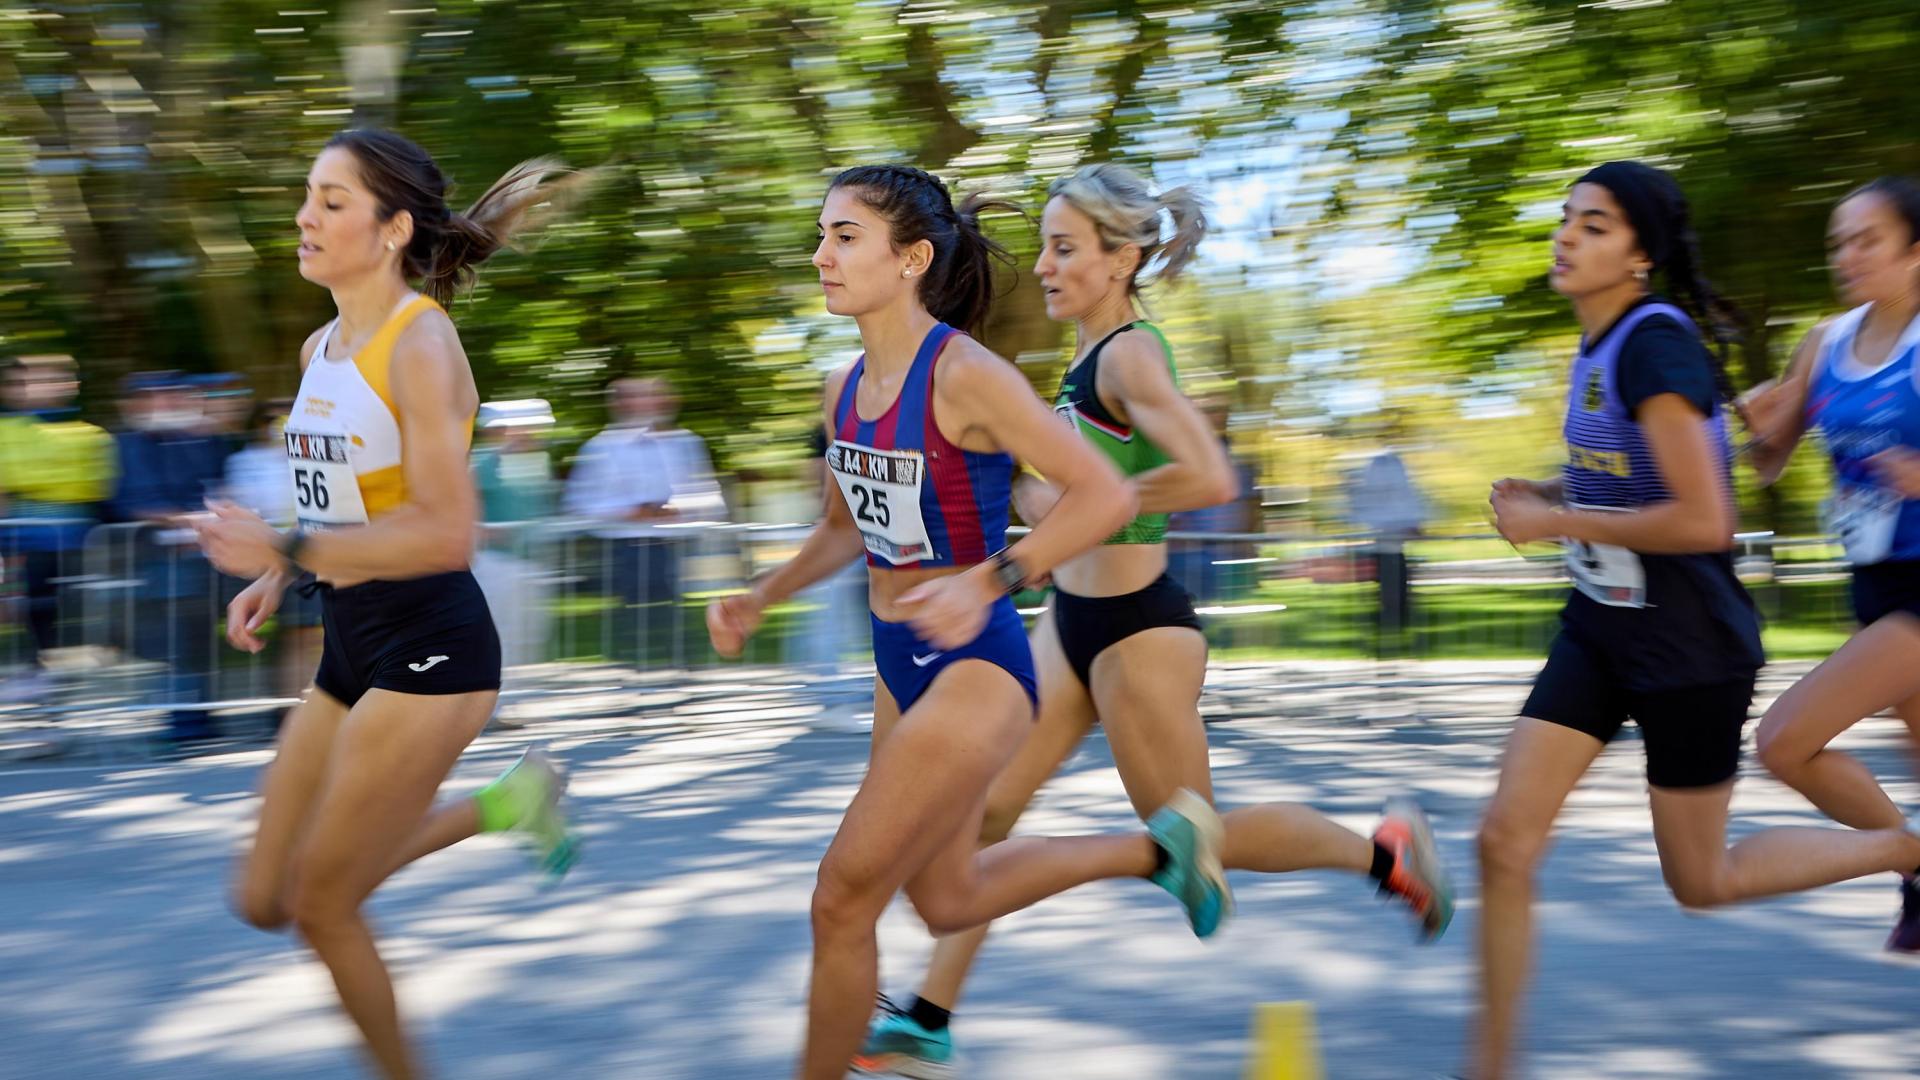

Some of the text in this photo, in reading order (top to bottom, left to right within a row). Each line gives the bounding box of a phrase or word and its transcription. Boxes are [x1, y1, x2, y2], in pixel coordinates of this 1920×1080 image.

[843, 448, 889, 482] A4XKM
[294, 467, 330, 512] 56
[851, 483, 891, 529] 25
